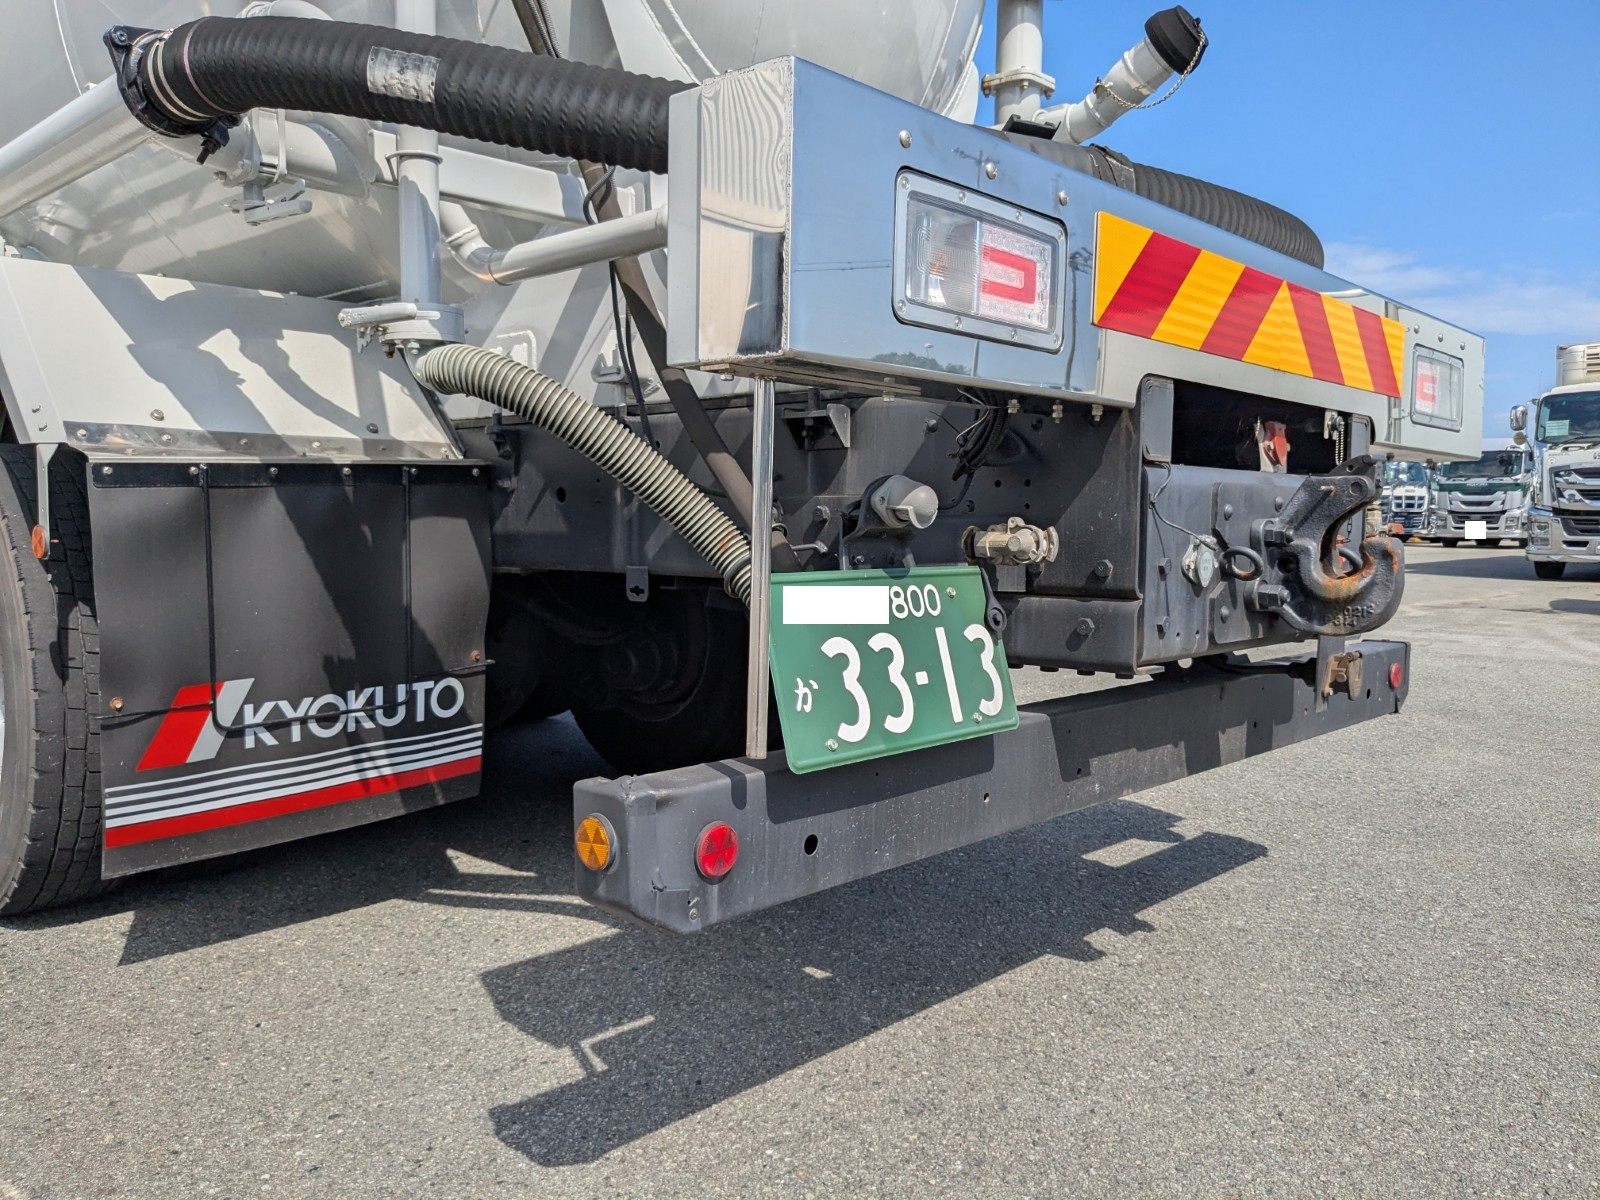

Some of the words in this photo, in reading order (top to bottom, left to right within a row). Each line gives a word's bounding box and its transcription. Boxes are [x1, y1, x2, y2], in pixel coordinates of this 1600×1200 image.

[889, 583, 941, 619] 800
[243, 676, 465, 750] KYOKUTO
[794, 677, 819, 713] か
[820, 623, 1004, 743] 33-13
